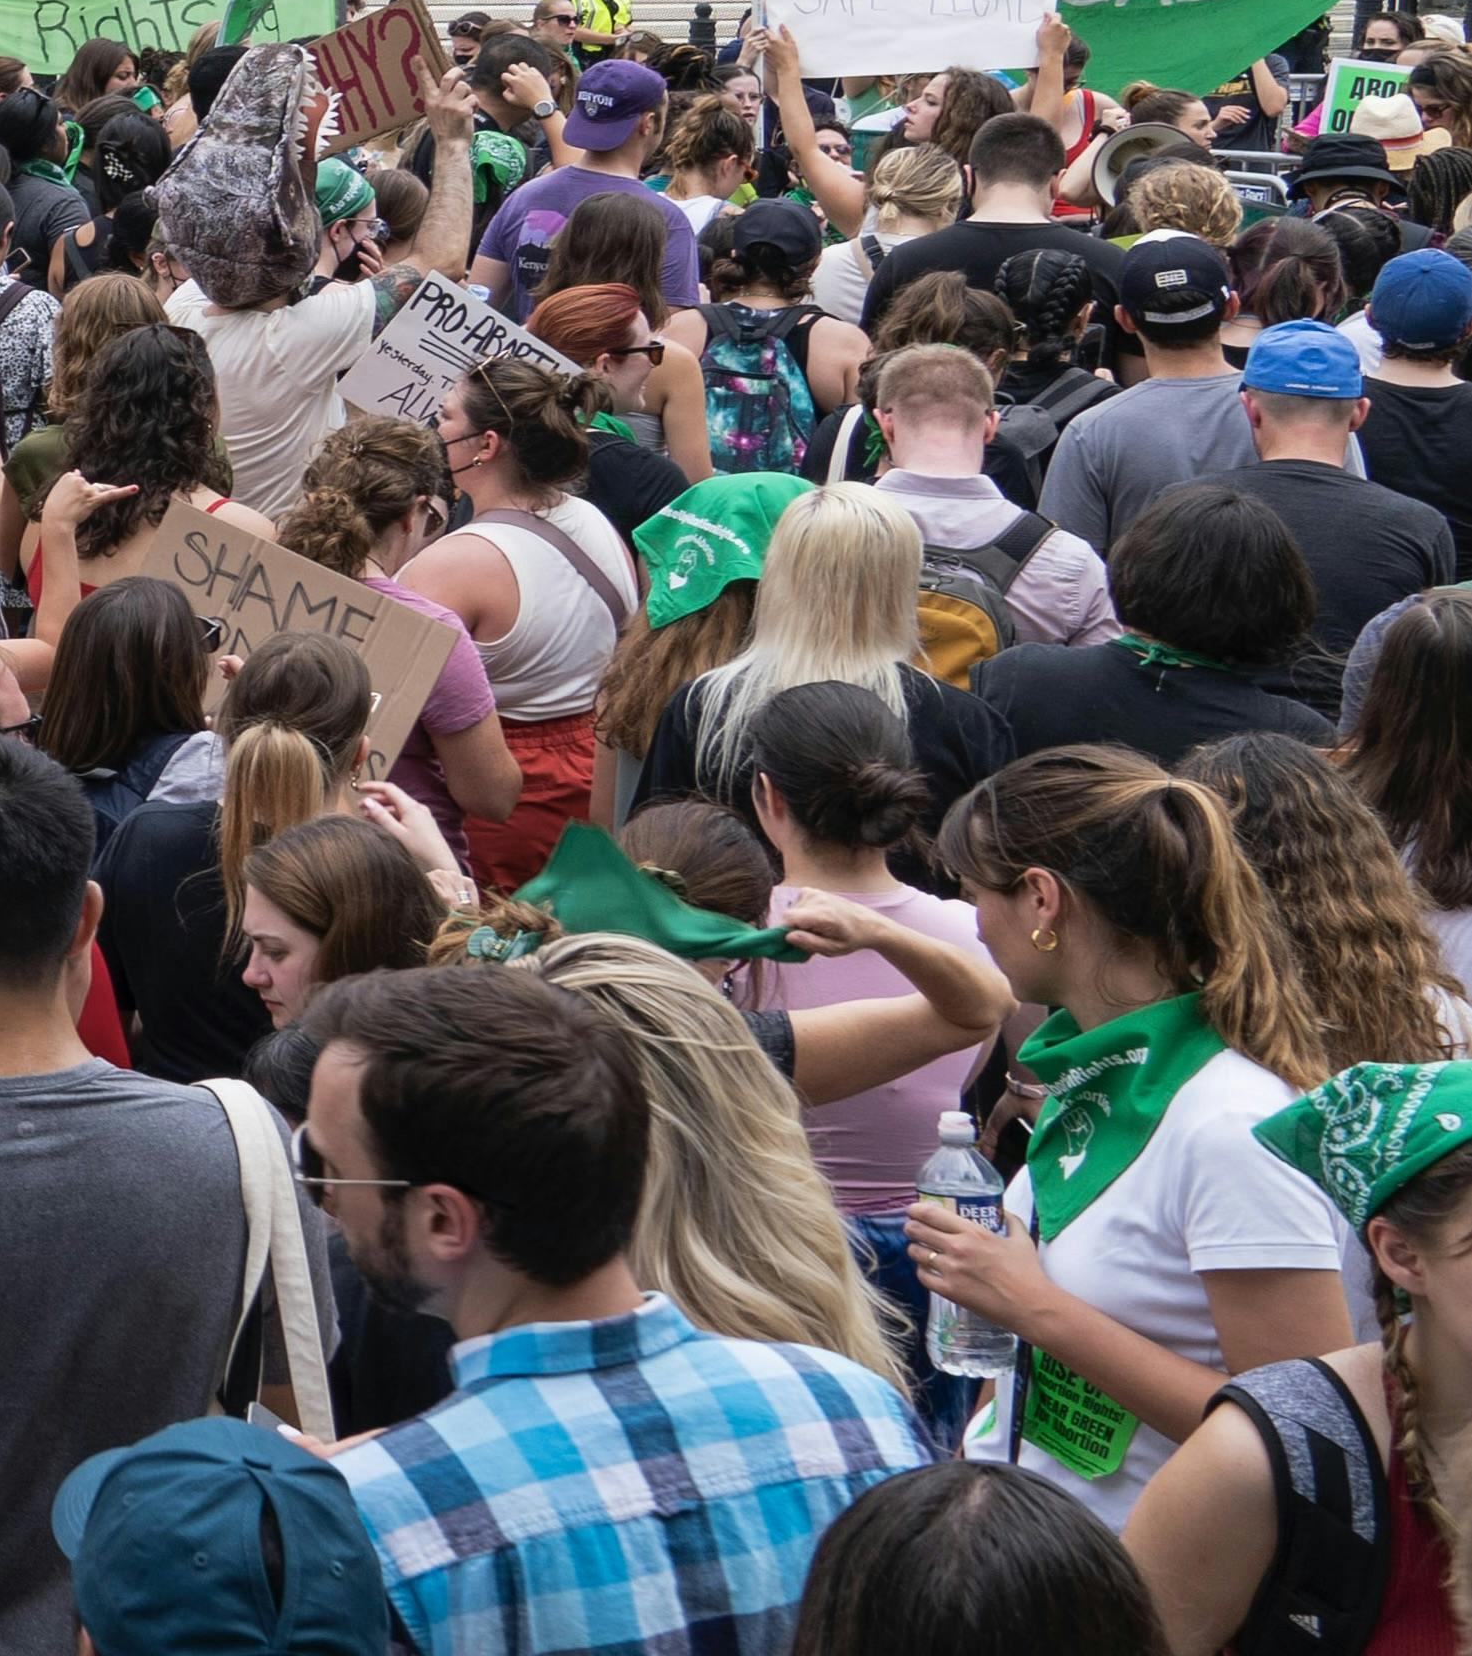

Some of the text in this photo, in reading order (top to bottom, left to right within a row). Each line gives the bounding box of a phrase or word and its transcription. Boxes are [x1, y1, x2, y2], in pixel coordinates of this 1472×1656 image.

[576, 90, 614, 107] KENYON
[409, 280, 563, 378] PRO-ABORTI
[173, 531, 376, 643] SHAME
[959, 1205, 998, 1218] DEER
[1038, 1350, 1083, 1387] RISE
[1037, 1372, 1125, 1427] Abortion Rights!
[1038, 1393, 1116, 1443] WEAR GREEN
[1035, 1408, 1051, 1427] for
[1052, 1414, 1110, 1460] Abortion
